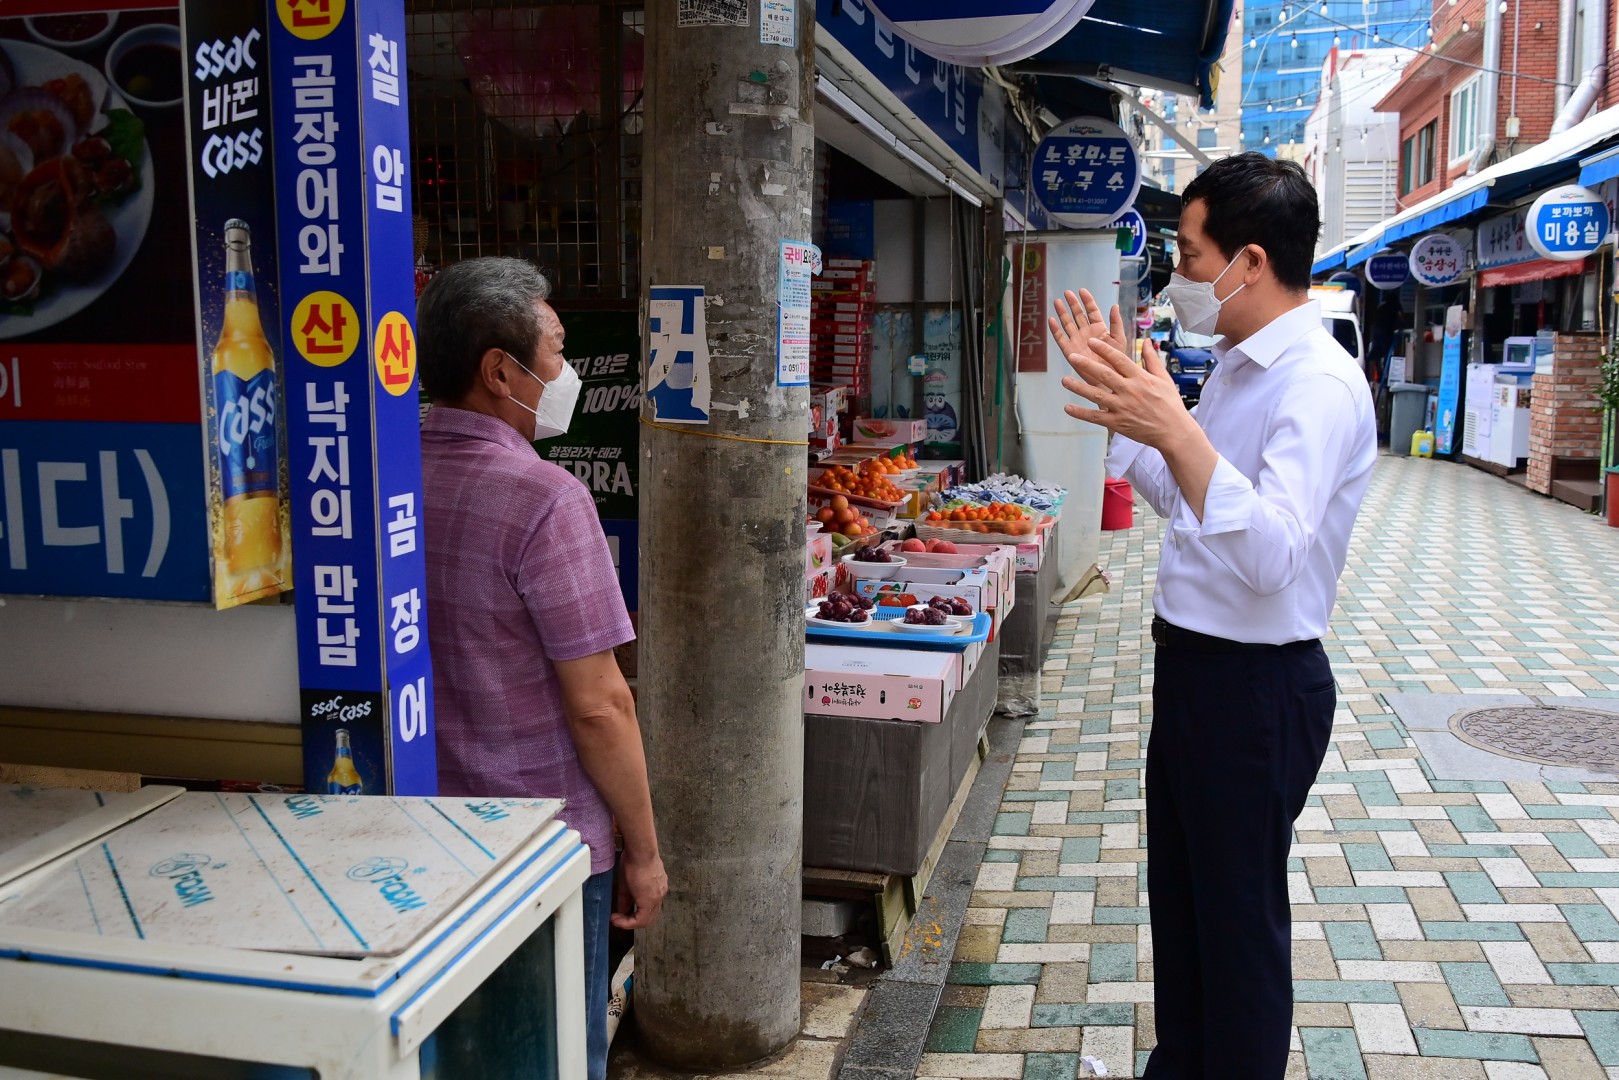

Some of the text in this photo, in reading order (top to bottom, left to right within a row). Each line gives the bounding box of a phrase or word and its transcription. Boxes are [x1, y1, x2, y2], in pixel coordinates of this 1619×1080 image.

[202, 76, 259, 131] 바뀐
[201, 127, 264, 179] Cass
[292, 55, 344, 276] 곰장어와
[1043, 144, 1127, 166] 노홍만두
[1042, 170, 1125, 192] 칼국수
[1544, 220, 1600, 246] 미용실
[1552, 205, 1594, 218] 뽀까뽀까
[301, 304, 347, 354] 산
[1020, 275, 1042, 355] 칼국수
[380, 322, 410, 386] 산
[591, 353, 630, 376] 않은
[305, 381, 353, 539] 낙지의
[314, 565, 361, 667] 만남
[388, 492, 428, 743] 곰장어
